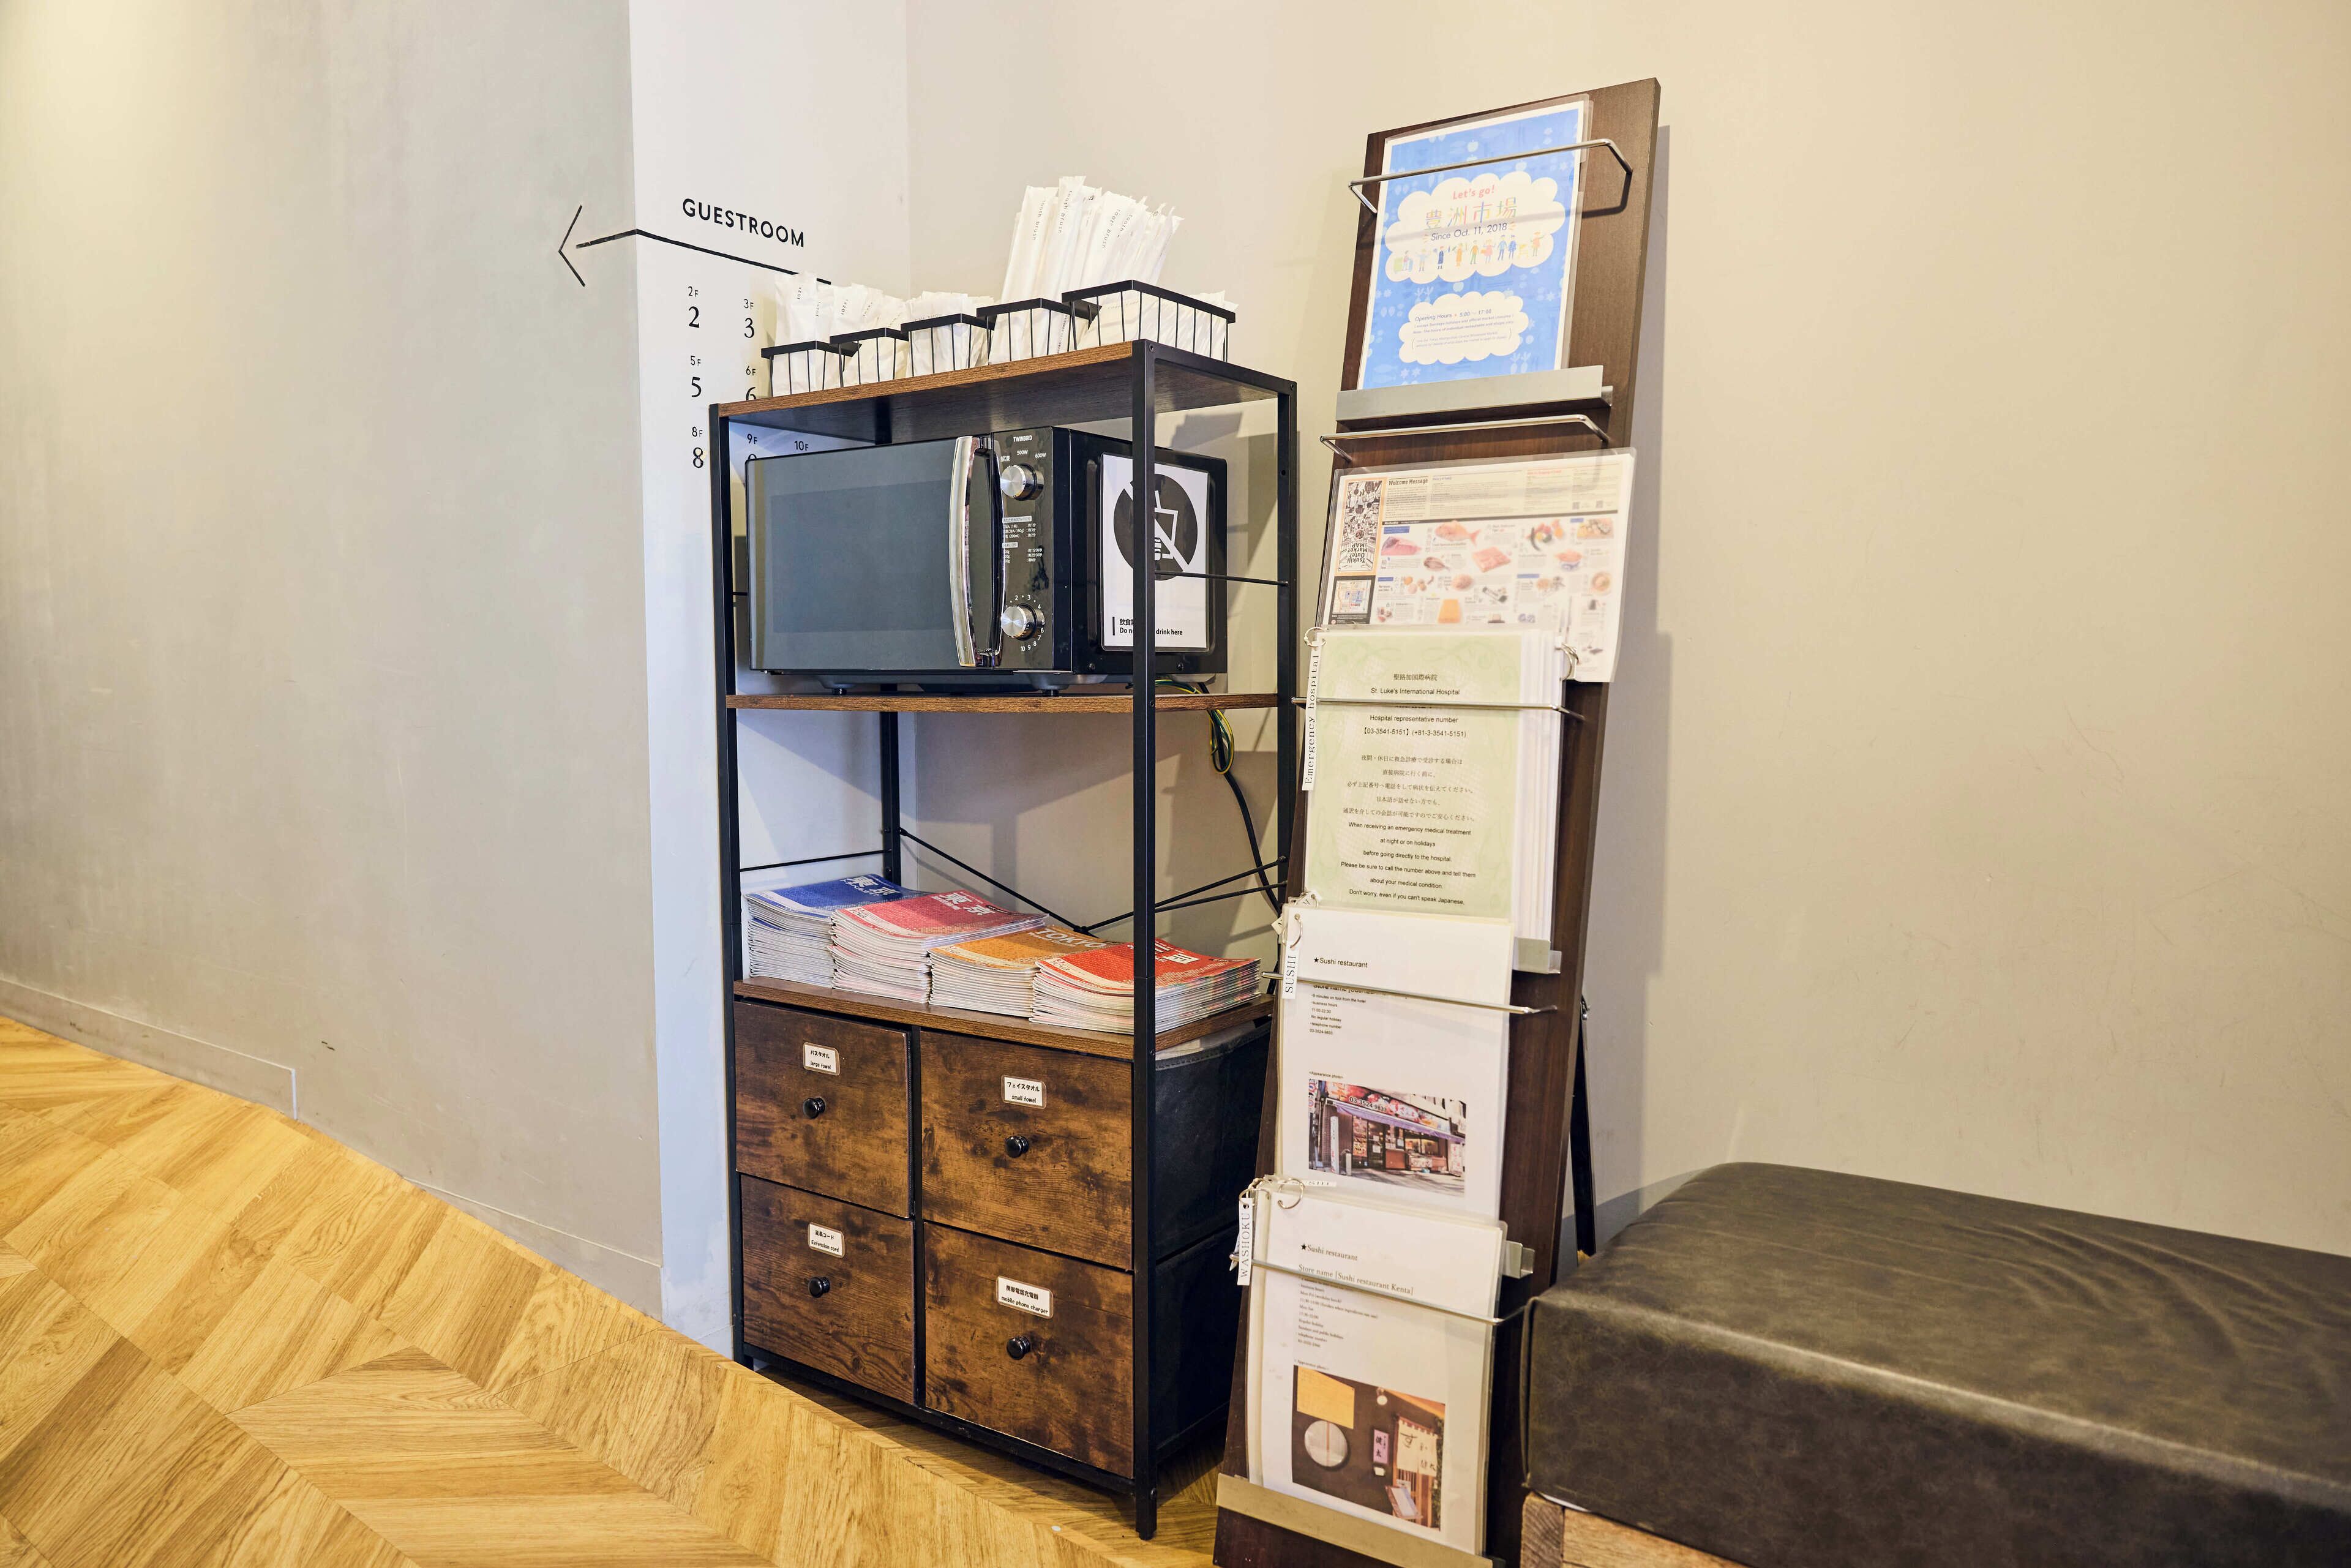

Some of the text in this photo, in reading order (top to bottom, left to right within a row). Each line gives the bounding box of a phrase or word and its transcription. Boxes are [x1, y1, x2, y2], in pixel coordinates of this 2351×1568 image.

[1453, 184, 1494, 200] Let's go!
[683, 198, 804, 247] GUESTROOM
[1424, 197, 1517, 230] 豊洲市場
[1431, 222, 1507, 241] Since Oct. 11, 2018
[688, 286, 699, 298] 2F
[744, 298, 754, 310] 3F
[689, 306, 700, 328] 2
[744, 317, 755, 339] 3
[690, 355, 701, 367] 5F
[746, 365, 756, 377] 6F
[691, 377, 702, 397] 5
[691, 426, 703, 438] 8F
[747, 433, 758, 445] 9F
[794, 440, 809, 451] 10F
[692, 447, 704, 468] 8
[1305, 656, 1319, 784] Emergency hospital
[847, 876, 902, 896] 東京
[943, 893, 996, 916] 東京
[1036, 928, 1107, 948] TOKYO
[1007, 1082, 1040, 1092] フェイスタオル
[812, 1240, 830, 1249] Extension
[1240, 1213, 1250, 1278] WASHOKU
[1307, 1244, 1357, 1261] Sushi restaurant
[1299, 1264, 1314, 1274] Store
[1316, 1268, 1333, 1277] name
[1357, 1278, 1389, 1290] restaurant
[1006, 1285, 1039, 1300] 携帯電話充電器
[1031, 1305, 1048, 1313] charger
